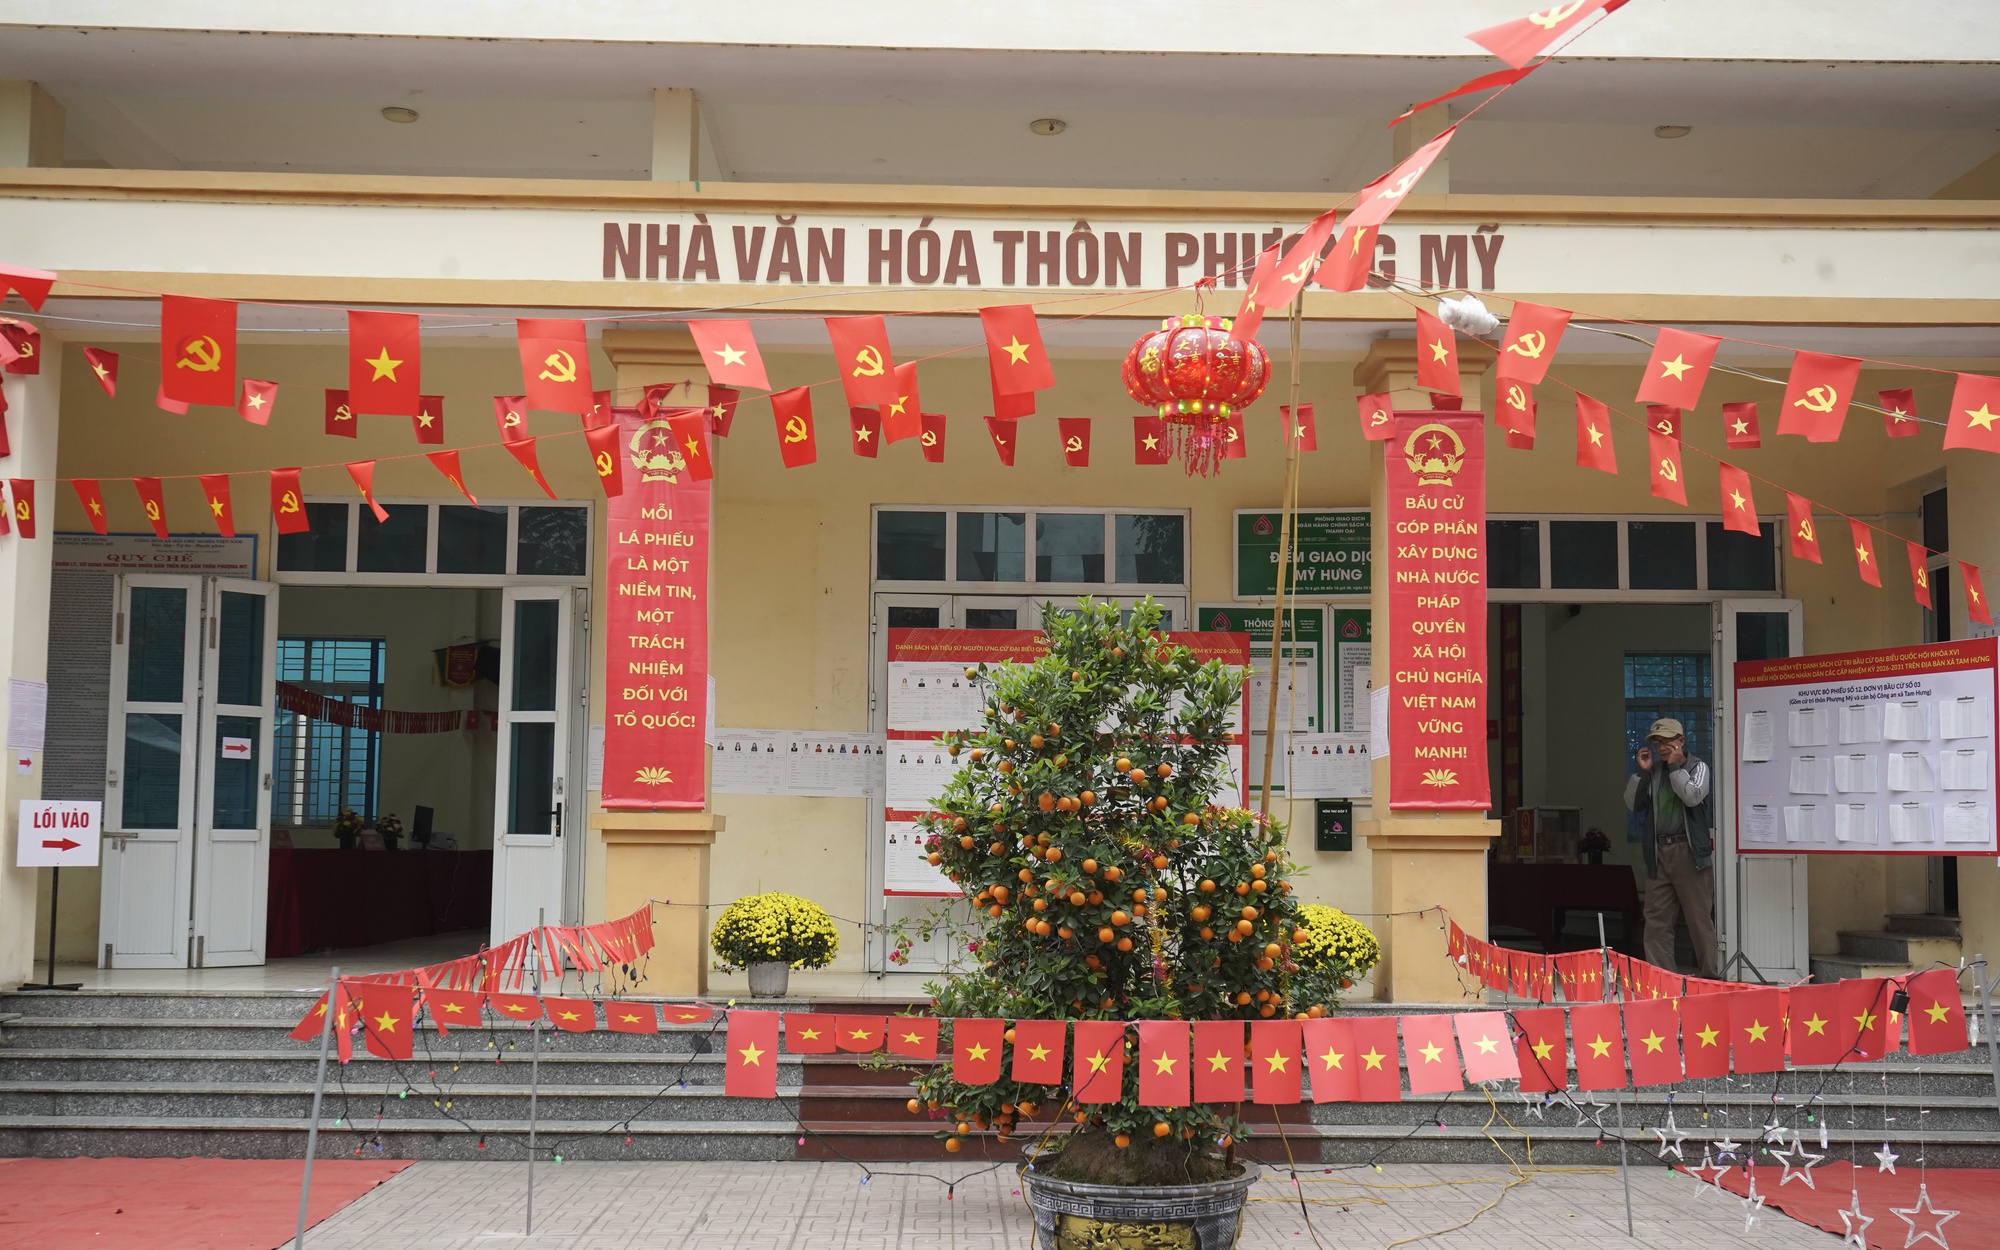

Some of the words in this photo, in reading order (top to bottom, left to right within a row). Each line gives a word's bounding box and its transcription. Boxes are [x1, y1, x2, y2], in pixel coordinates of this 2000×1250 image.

[602, 213, 720, 281] NHÀ
[732, 214, 845, 284] VĂN
[868, 217, 981, 286] HÓA
[993, 220, 1141, 287] THÔN
[1165, 227, 1396, 289] PHƯG
[1419, 224, 1505, 290] MỸ
[1405, 494, 1438, 510] BẦU
[1442, 494, 1465, 510] CỬ
[641, 503, 672, 520] MỖI
[1396, 520, 1429, 534] GÓP
[1434, 519, 1478, 535] PHẦN
[619, 531, 640, 545] LÁ
[645, 529, 694, 547] PHIẾU
[107, 554, 147, 562] QUY
[153, 553, 193, 562] CHẾ
[1270, 546, 1304, 563] ĐỂM
[1309, 551, 1346, 563] GIAO
[1351, 551, 1371, 566] DỊC
[1397, 546, 1428, 559] XÂY
[1432, 547, 1478, 563] DỰNG
[627, 556, 649, 571] LÀ
[653, 557, 690, 575] MỘT
[1296, 567, 1316, 580] MỸ
[1321, 568, 1362, 580] HƯNG
[1397, 569, 1430, 584] NHÀ
[1434, 570, 1480, 585] NƯỚC
[619, 580, 661, 597] NIỀM
[666, 585, 696, 601] TIN,
[1417, 594, 1460, 608] PHÁP
[637, 610, 674, 625] MỘT
[1244, 618, 1275, 628] THÔNG
[1412, 618, 1465, 635] QUYỀN
[629, 633, 684, 650] TRÁCH
[1412, 645, 1434, 658] XÃ
[1438, 644, 1466, 661] HỘI
[1886, 653, 1898, 661] BIỂU
[1900, 651, 1918, 661] QUỐC
[1918, 651, 1930, 659] HỘI
[1930, 649, 1948, 658] KHÓA
[629, 660, 683, 678] NHIỆM
[1396, 667, 1428, 683] CHỦ
[1433, 669, 1483, 684] NGHĨA
[1848, 666, 1866, 674] NHIỆM
[1876, 664, 1904, 672] 2026-2031
[1905, 661, 1920, 669] TRÊN
[622, 684, 654, 701] ĐỐI
[658, 687, 688, 702] VỚI
[1831, 686, 1847, 694] PHIẾU
[1884, 682, 1895, 690] BẦU
[1896, 682, 1905, 690] CỬ
[1402, 695, 1437, 711] VIỆT
[1442, 696, 1476, 708] NAM
[1826, 695, 1845, 703] Phượng
[1877, 690, 1890, 699] Công
[614, 710, 637, 727] TỔ
[642, 711, 696, 729] QUỐC!
[1418, 720, 1463, 734] VỮNG
[1414, 746, 1467, 762] MẠNH!
[34, 807, 56, 828] LỐI
[61, 808, 90, 828] VÀO
